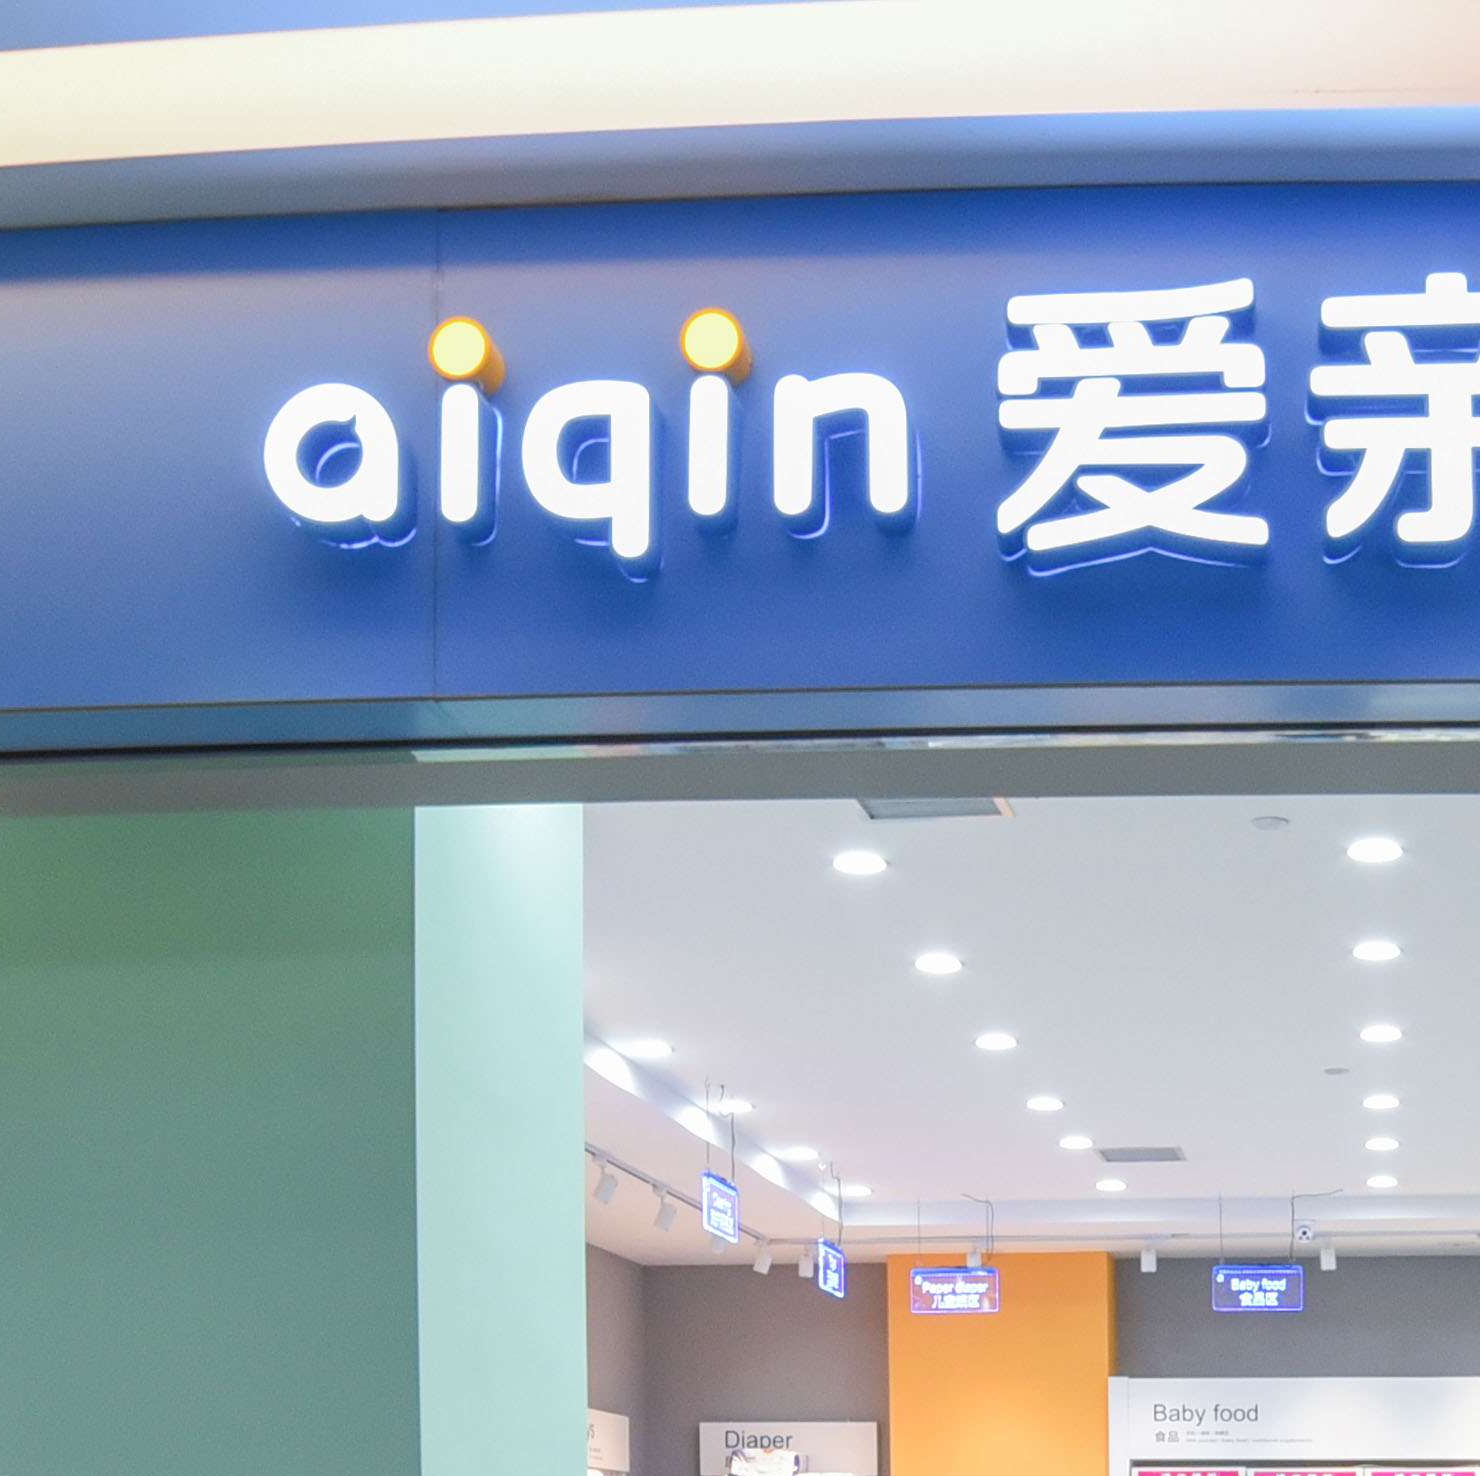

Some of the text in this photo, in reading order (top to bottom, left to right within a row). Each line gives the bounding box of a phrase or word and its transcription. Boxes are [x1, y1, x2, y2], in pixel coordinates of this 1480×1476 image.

[262, 308, 910, 562] aiqin
[1230, 1277, 1287, 1294] Baby food
[1152, 1403, 1259, 1427] Baby food
[724, 1430, 795, 1451] Diaper
